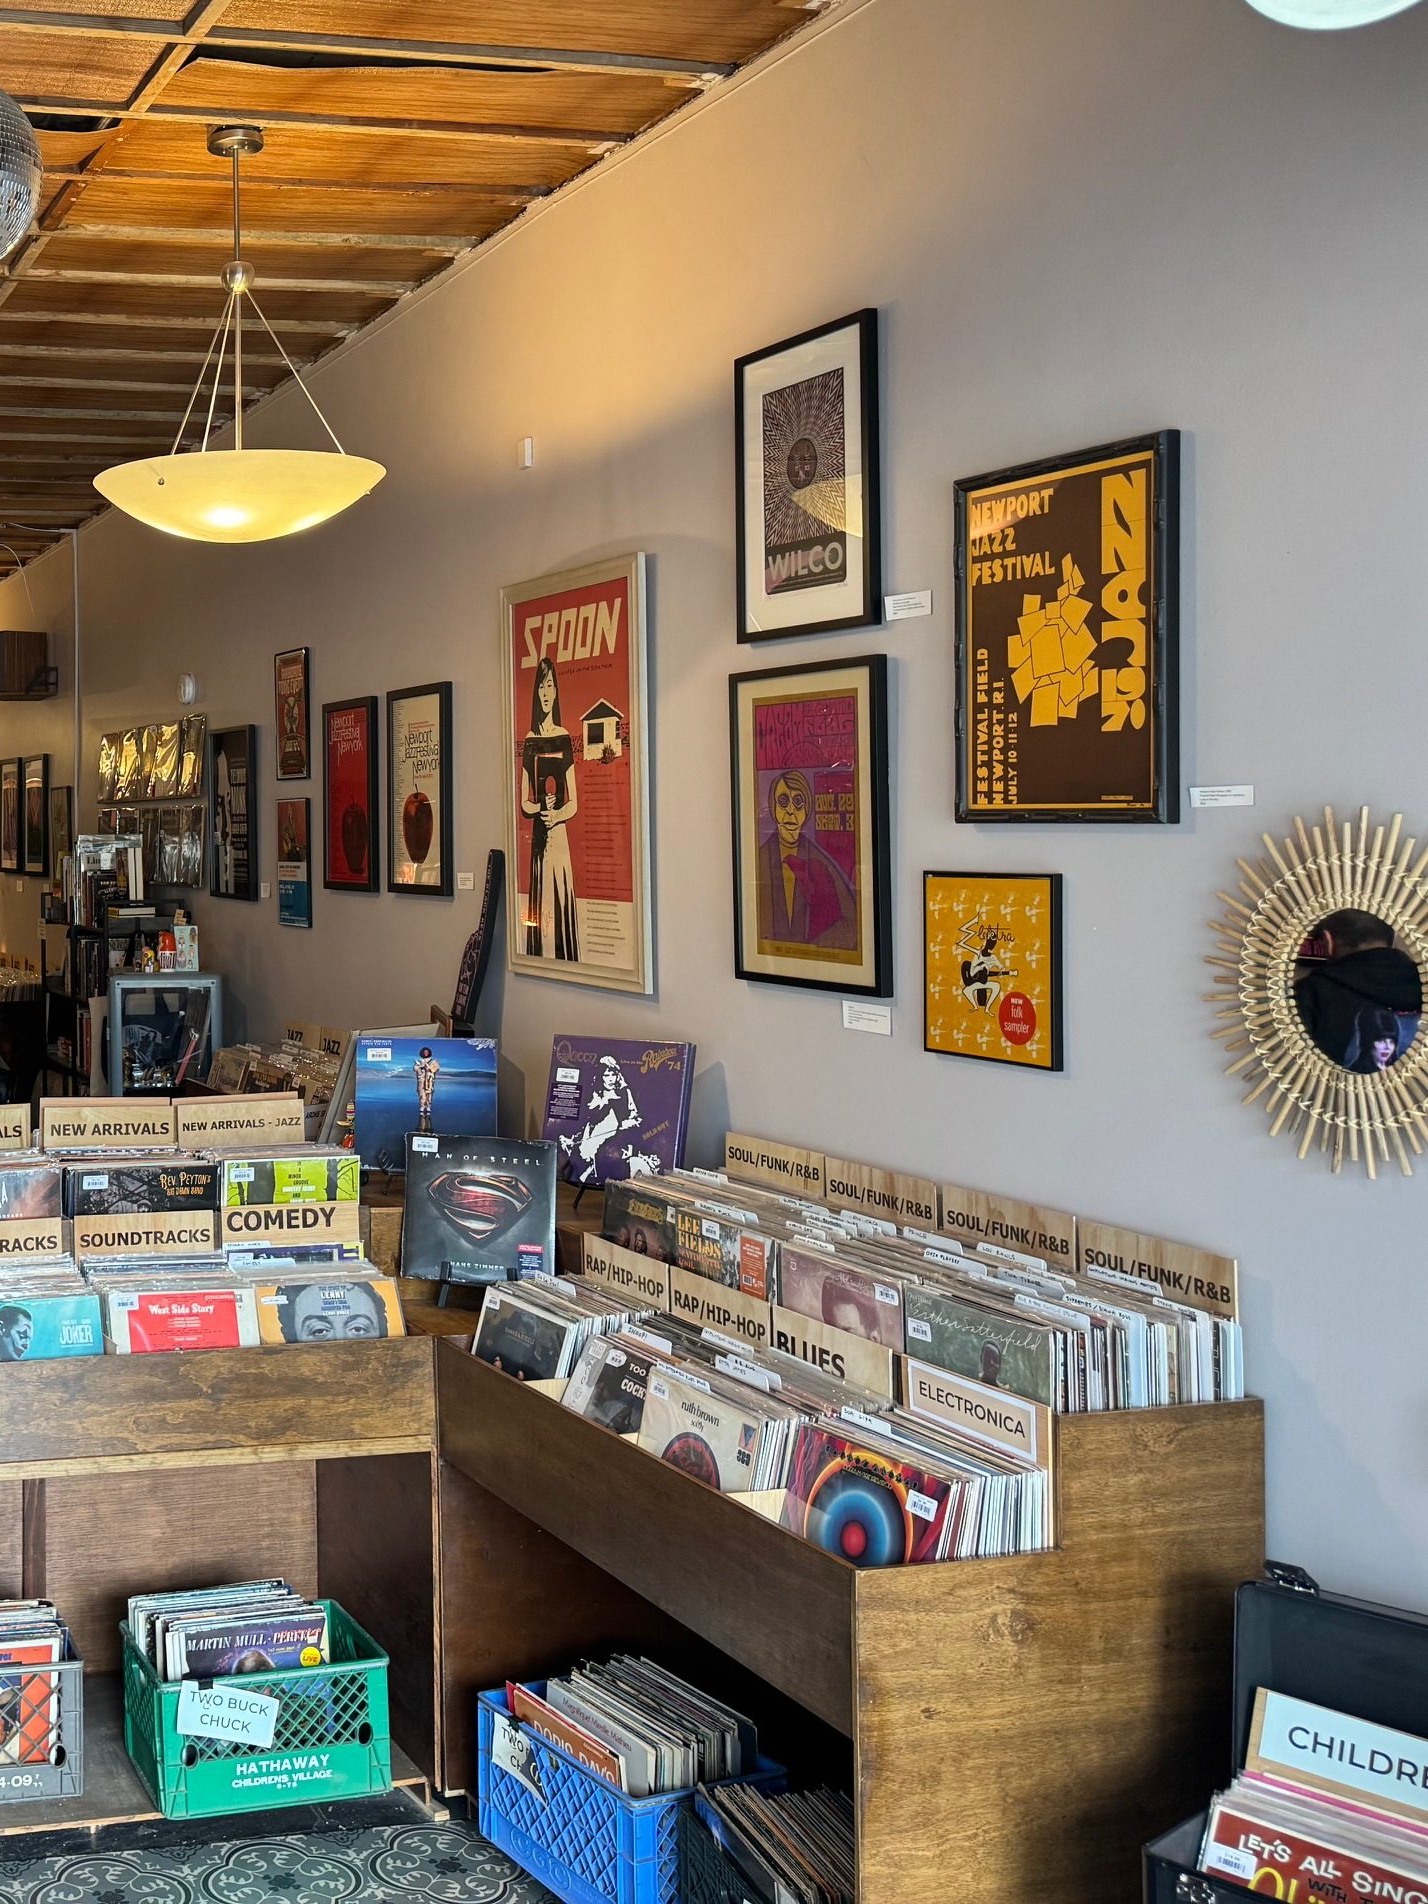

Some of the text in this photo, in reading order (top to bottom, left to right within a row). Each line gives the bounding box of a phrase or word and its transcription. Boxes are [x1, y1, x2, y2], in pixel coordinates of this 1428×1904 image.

[971, 488, 1055, 530] NEWPORT
[971, 527, 1017, 558] JAZZ
[767, 541, 844, 581] WILCO
[971, 551, 1056, 587] FESTIVAL
[521, 597, 622, 669] SPOON
[405, 728, 432, 748] Newport
[976, 647, 989, 805] FESTIVAL FIELD
[1007, 766, 1018, 805] JULY
[1011, 1004, 1023, 1019] folk
[1004, 1020, 1030, 1036] sampler
[322, 1038, 341, 1055] JAZZ
[50, 1122, 170, 1137] NEW ARRIVALS
[182, 1121, 208, 1132] NEW
[210, 1118, 265, 1130] ARRIVALS
[275, 1116, 301, 1128] JAZZ
[422, 1152, 453, 1160] MAN
[490, 1156, 541, 1166] STEEL
[728, 1146, 820, 1181] SOUL/FUNK/R&B
[830, 1179, 933, 1220] SOUL/FUNK/R&B
[226, 1207, 336, 1232] COMEDY
[677, 1214, 700, 1235] LEE
[947, 1210, 1070, 1255] SOUL/FUNK/R&B
[80, 1229, 211, 1248] SOUNDTRACKS
[677, 1230, 721, 1259] FIELDS
[474, 1263, 505, 1271] ZIMMER
[585, 1254, 664, 1299] RAP/HIP-HOP
[1085, 1249, 1231, 1304] SOUL/FUNK/R&B
[148, 1303, 215, 1315] West Side Story
[673, 1289, 766, 1341] RAP/HIP-HOP
[60, 1324, 94, 1345] JOKER
[910, 1303, 1042, 1356] Esther Satterfield
[776, 1330, 846, 1379] BLUES
[629, 1363, 647, 1377] TOO
[621, 1378, 647, 1400] COCK
[681, 1400, 720, 1428] ruth brown
[919, 1380, 1026, 1439] ELECTRONICA
[186, 1636, 232, 1652] MARTIN
[234, 1633, 267, 1648] MULL
[190, 1690, 269, 1717] TWO BUCK
[200, 1713, 252, 1734] CHUCK
[502, 1726, 524, 1753] TWO
[236, 1753, 330, 1776] HATHAWAY
[292, 1769, 332, 1782] VILLAGE
[1238, 1833, 1293, 1863] LET'S
[1298, 1855, 1343, 1880] ALL
[1308, 1878, 1347, 1903] WITH
